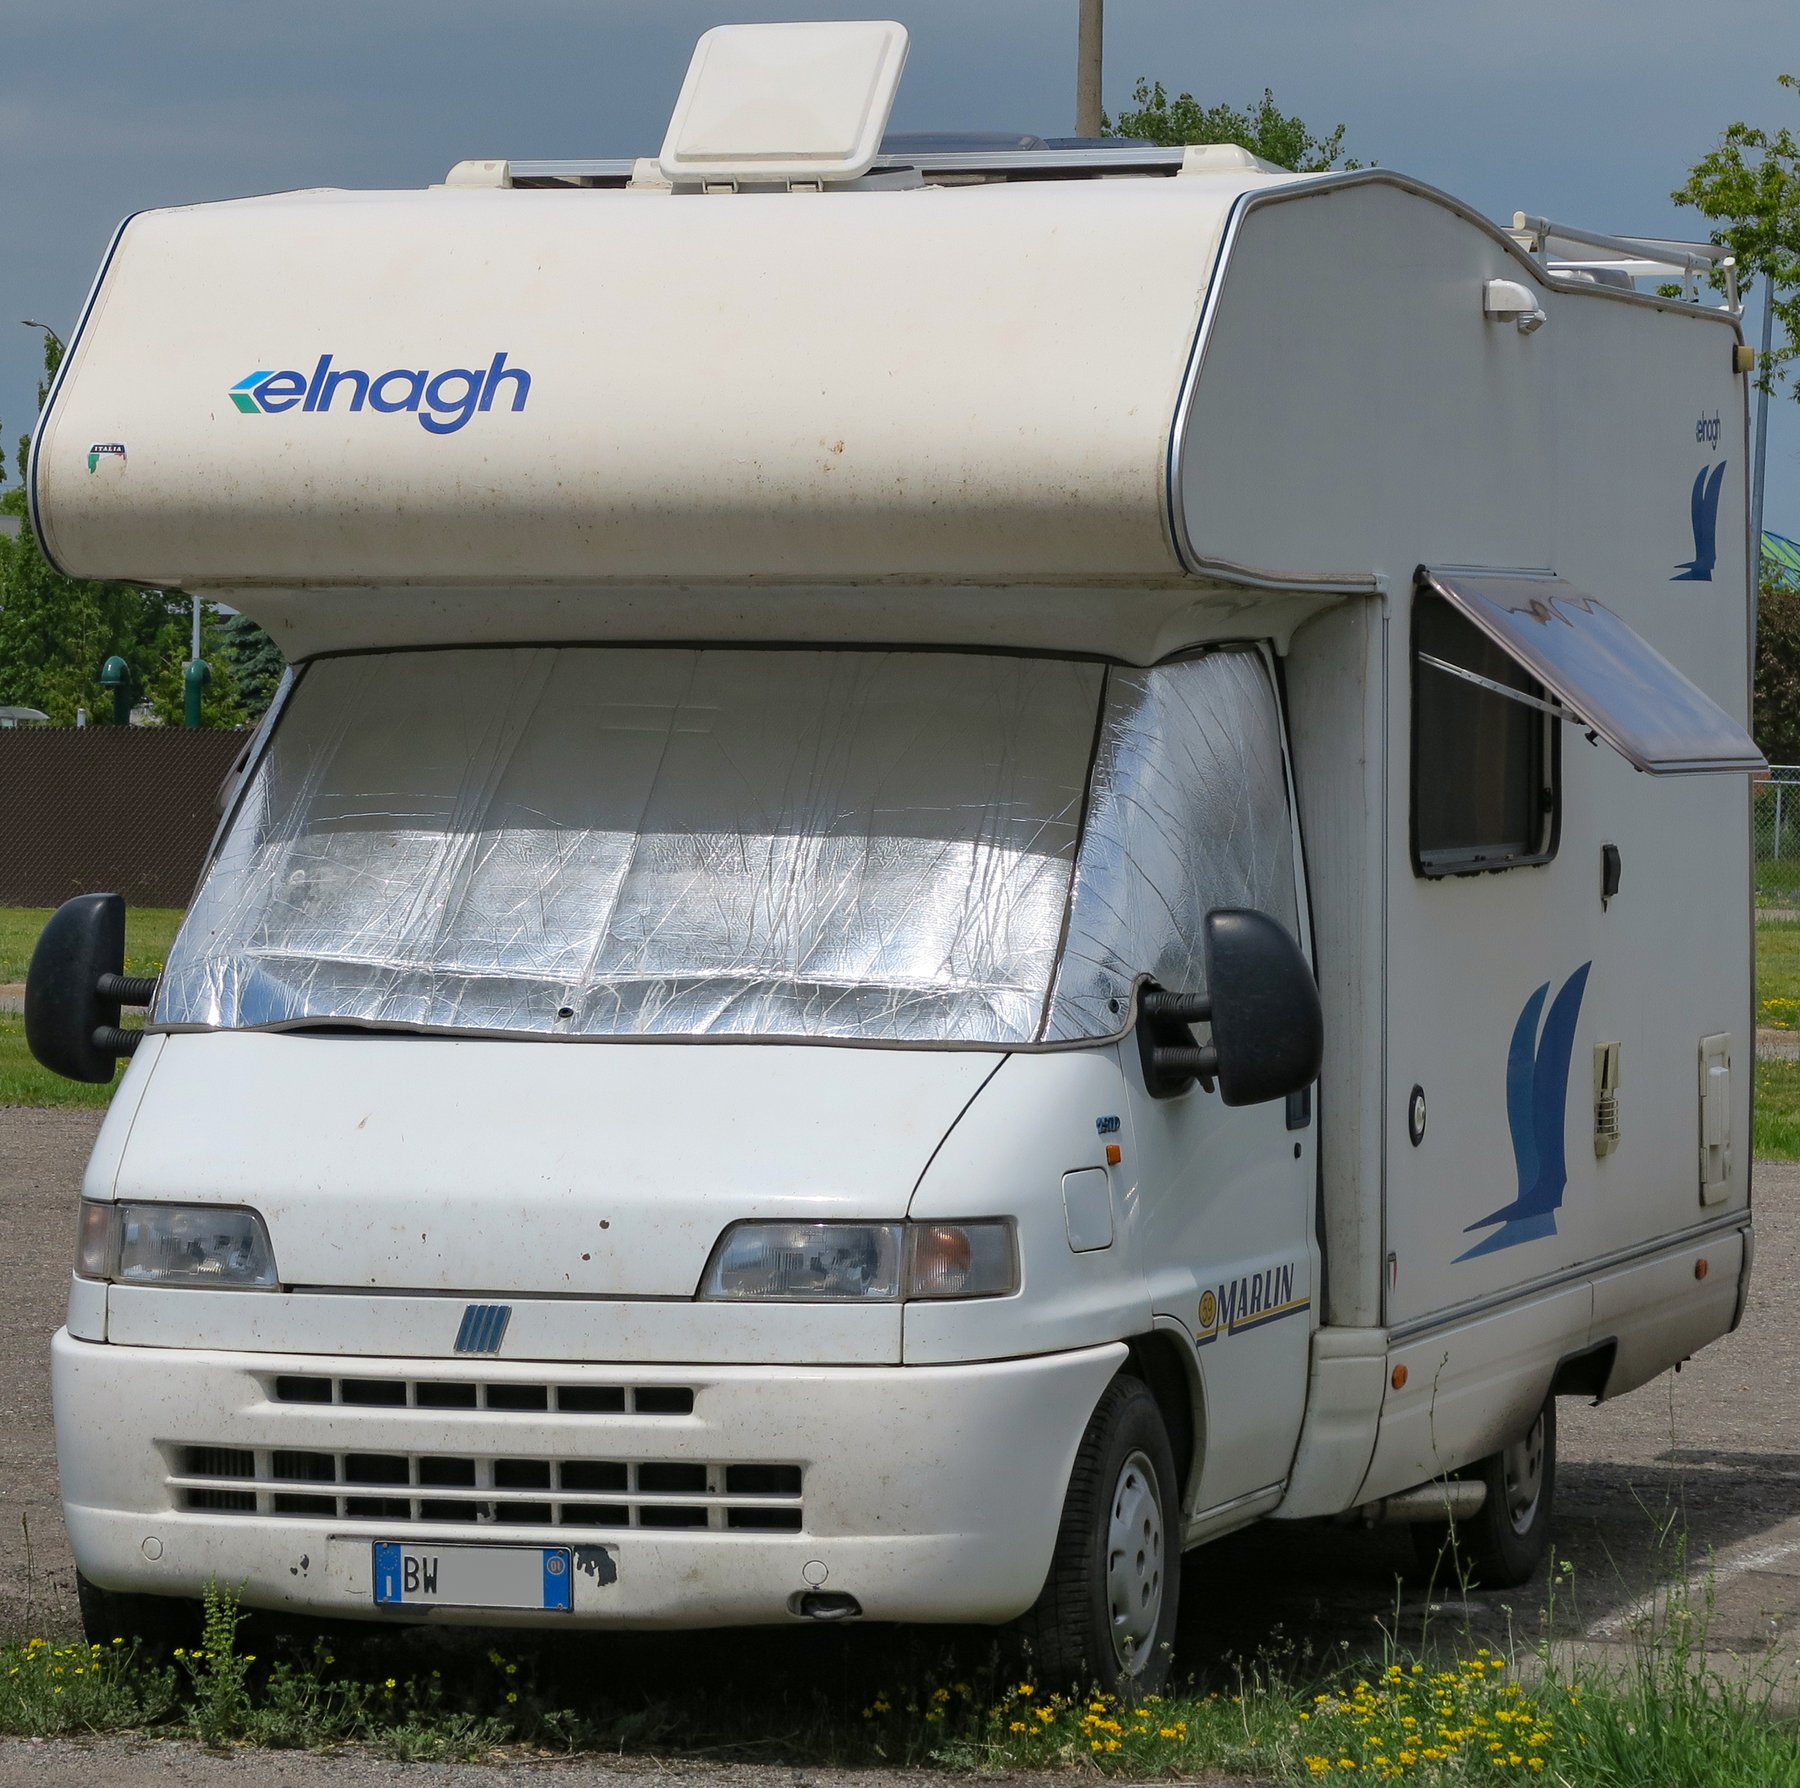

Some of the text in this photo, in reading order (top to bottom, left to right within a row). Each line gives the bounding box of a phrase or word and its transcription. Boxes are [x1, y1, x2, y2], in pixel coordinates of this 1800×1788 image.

[252, 352, 532, 435] elnagh
[1696, 409, 1721, 451] elnagh
[1217, 1262, 1294, 1337] MARLIN
[403, 1556, 439, 1593] BW
